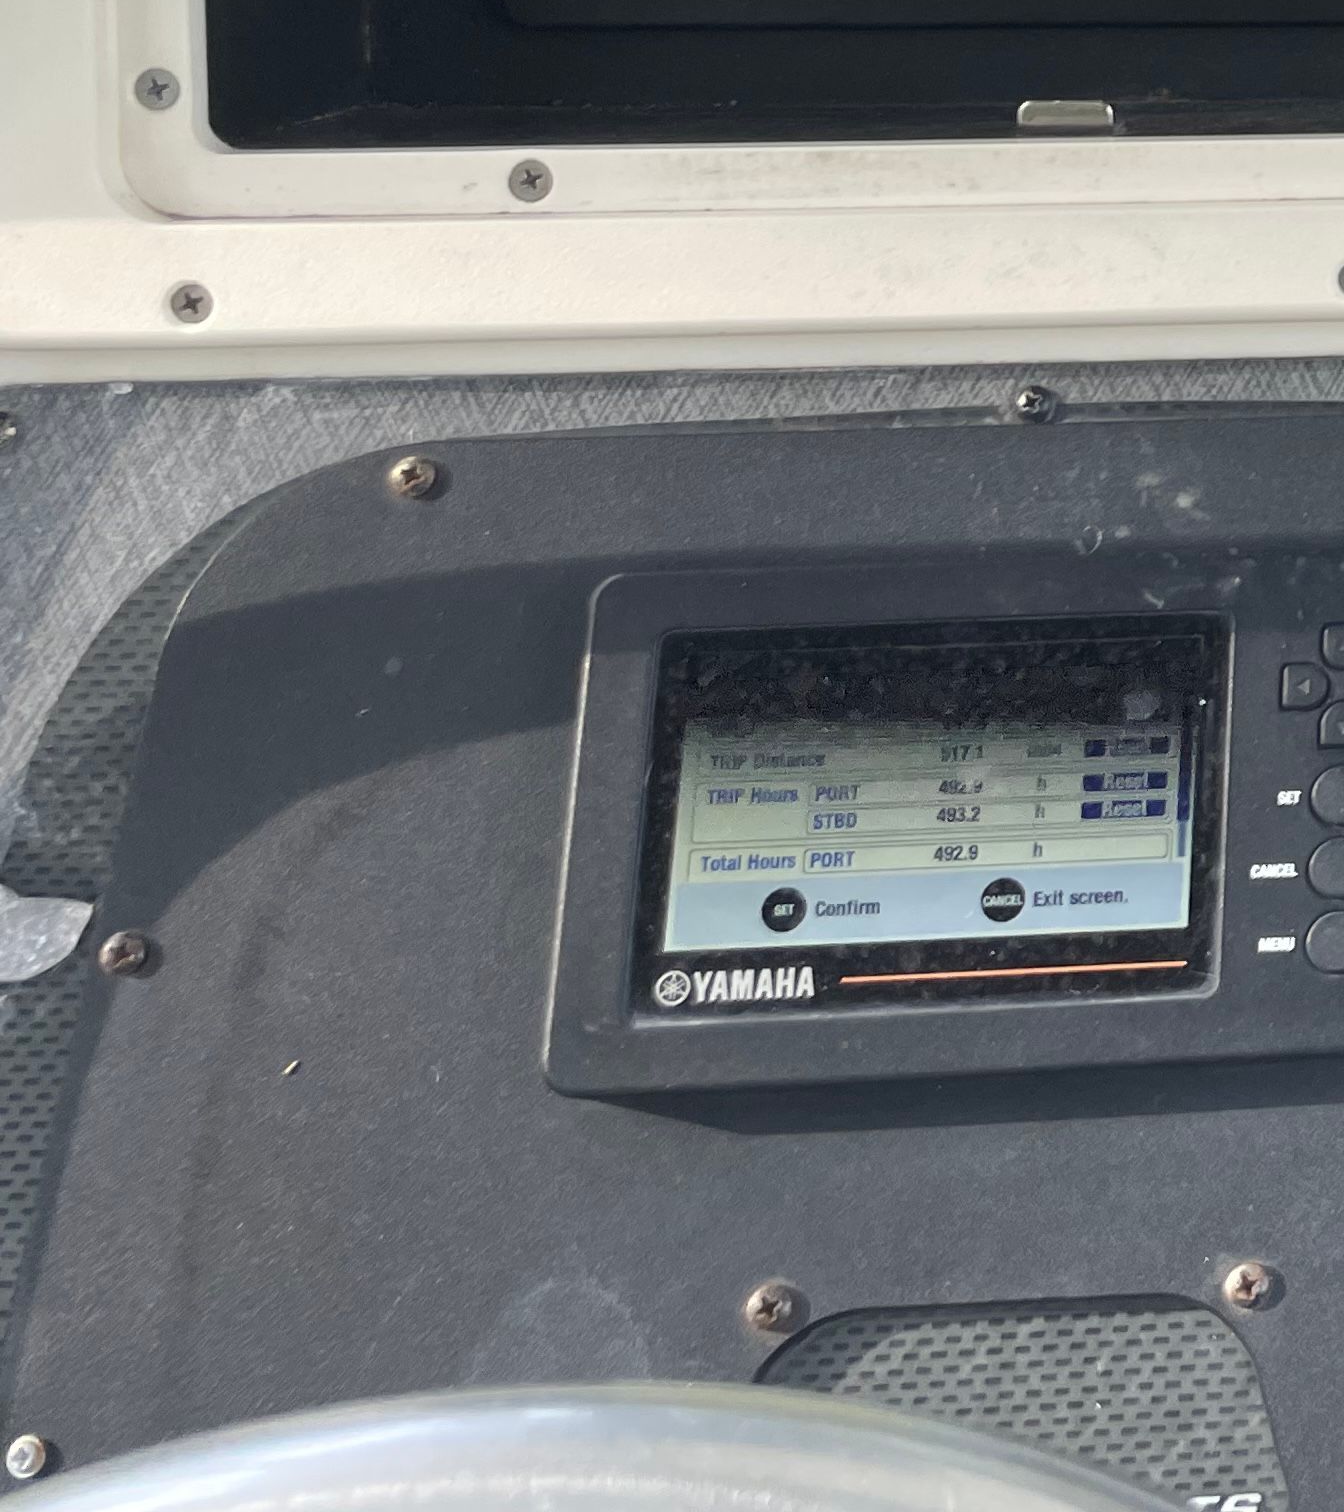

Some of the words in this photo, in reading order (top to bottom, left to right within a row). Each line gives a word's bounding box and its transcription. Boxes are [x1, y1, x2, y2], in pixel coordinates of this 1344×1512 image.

[815, 784, 861, 802] PORT
[813, 812, 858, 830] STBD
[937, 806, 981, 823] 493.2
[701, 854, 742, 872] Total
[747, 853, 797, 871] Hours
[810, 851, 856, 869] PORT
[934, 844, 979, 862] 492.9
[1032, 842, 1043, 858] h
[1249, 862, 1299, 880] CANCEL
[981, 893, 1024, 908] CANCEL
[1032, 891, 1065, 907] Exit
[1069, 889, 1129, 905] screen.
[815, 900, 881, 918] Confirm
[1257, 936, 1296, 952] MENU
[692, 966, 816, 1004] YAMAHA
